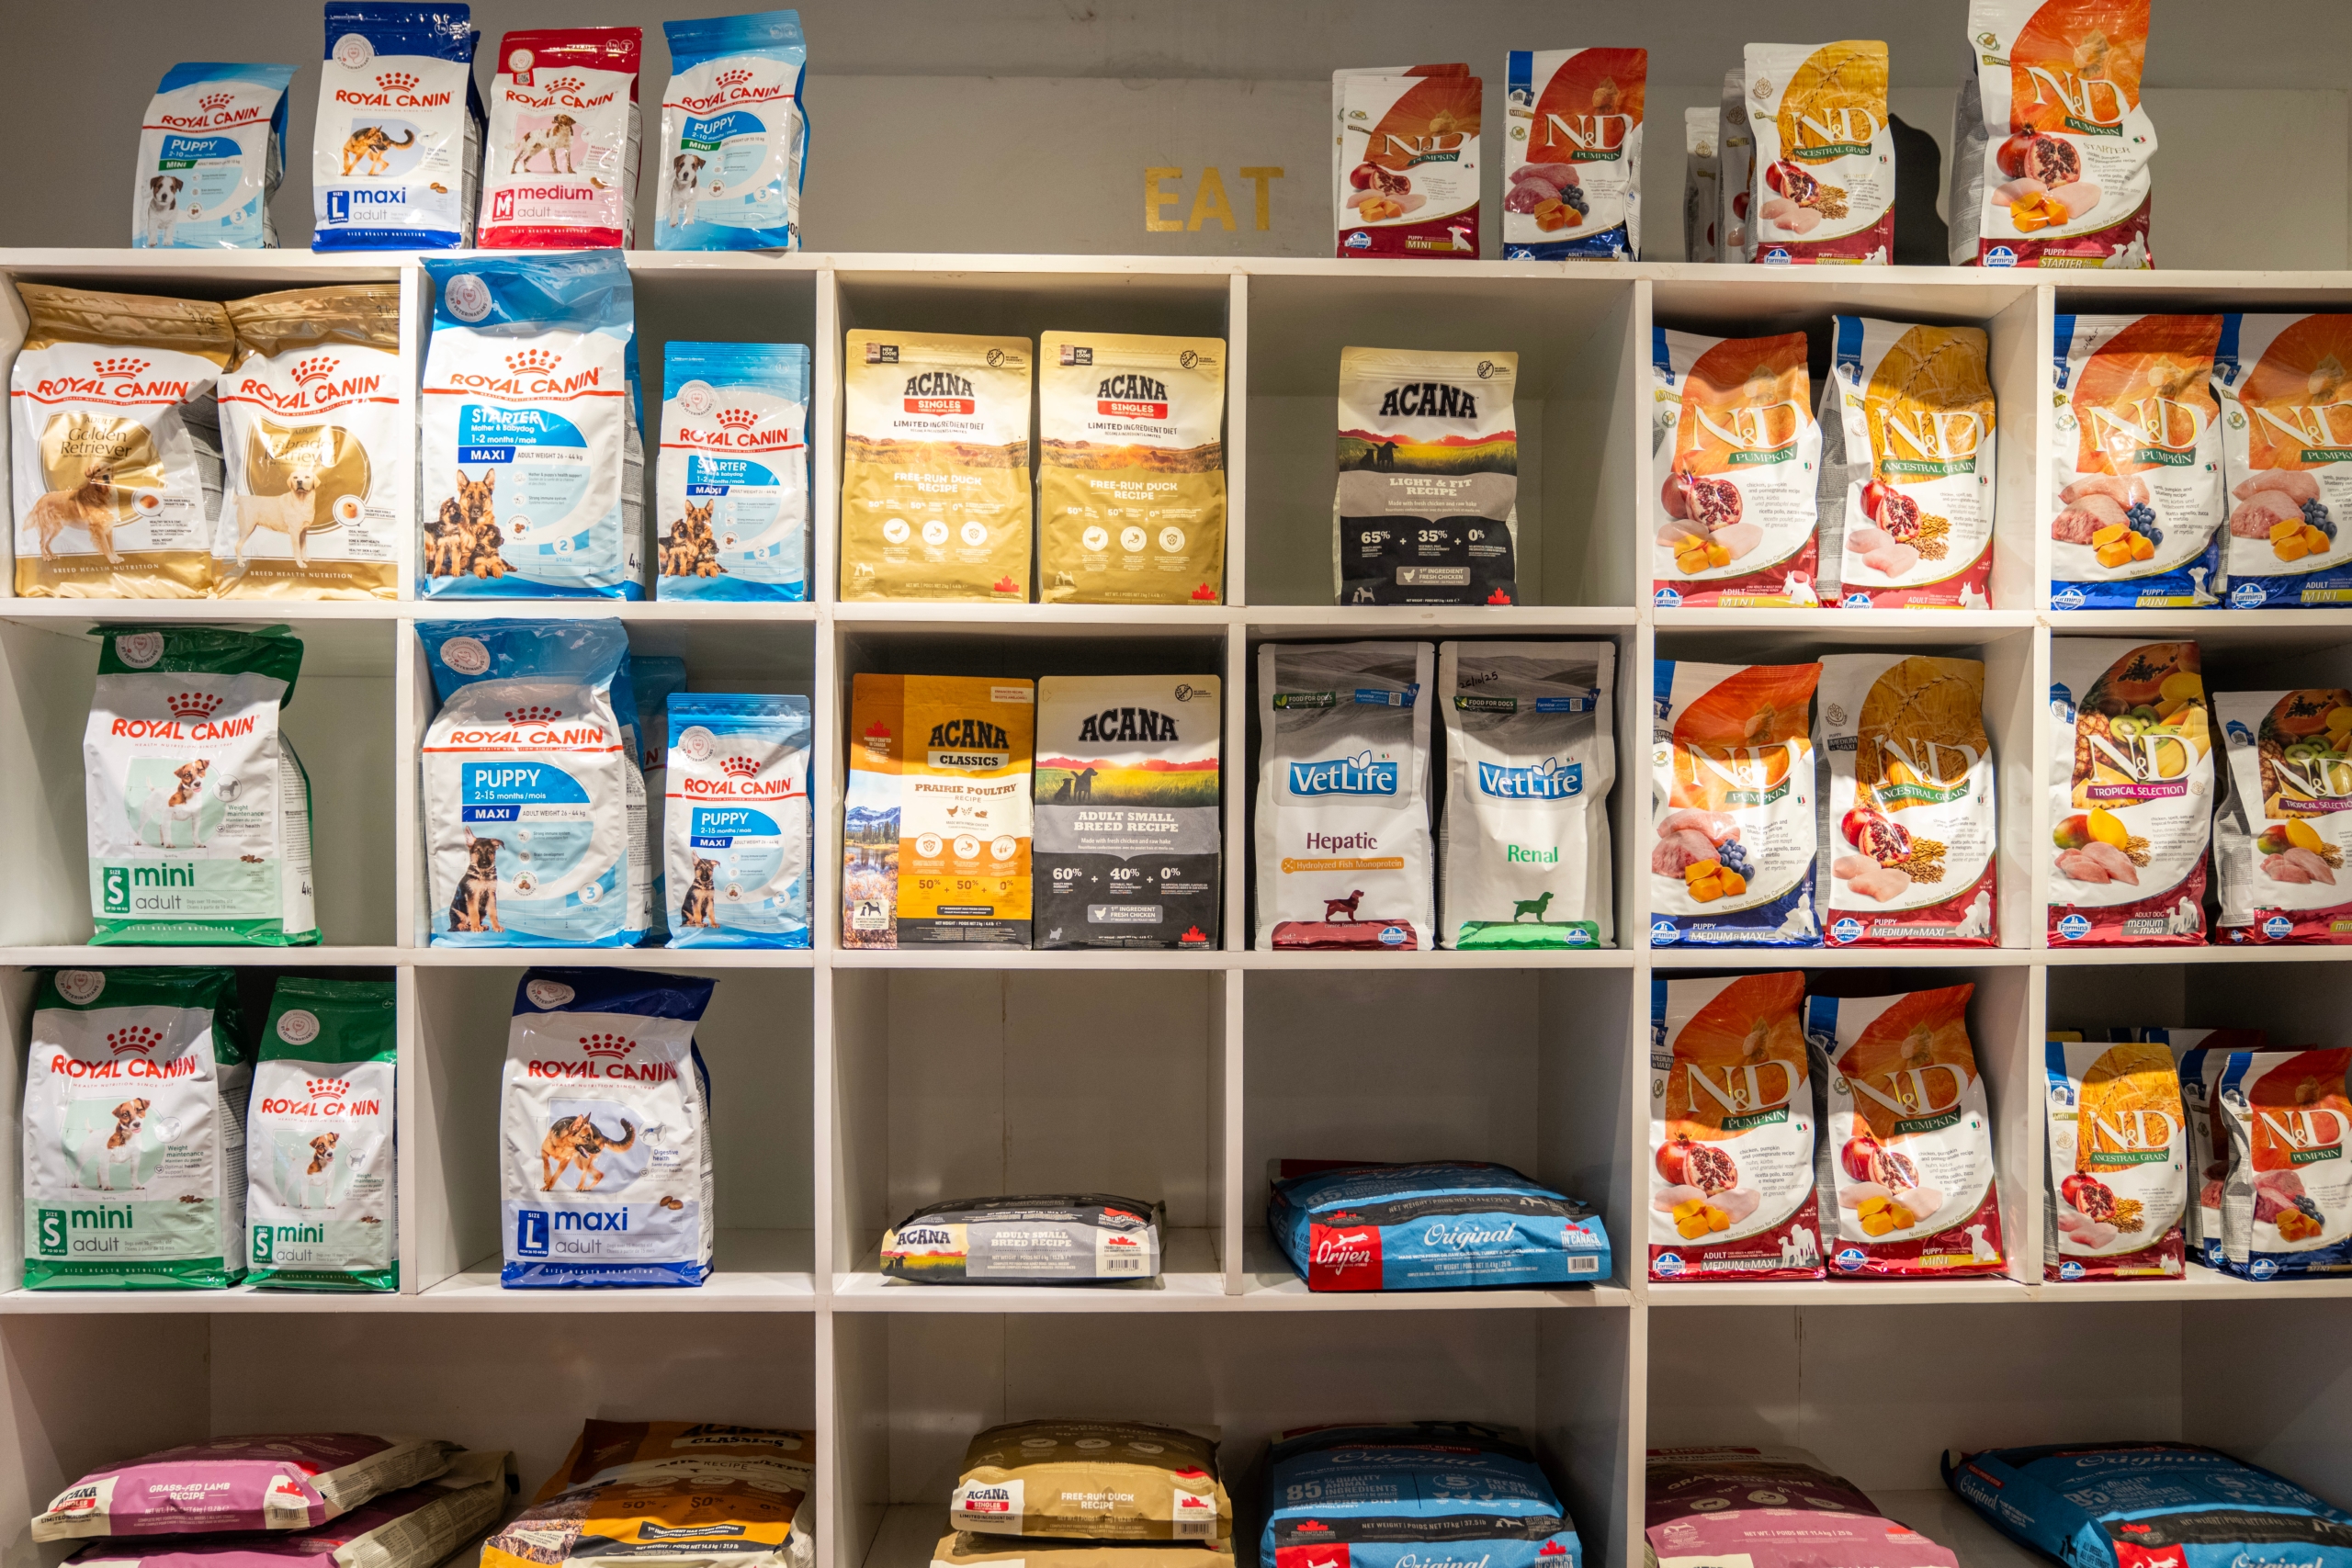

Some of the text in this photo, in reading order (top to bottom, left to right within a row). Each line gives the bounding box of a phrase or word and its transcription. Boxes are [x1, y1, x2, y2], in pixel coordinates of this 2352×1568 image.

[336, 90, 451, 107] ROYAL CANIN
[506, 90, 614, 108] ROYAL CANIN
[682, 85, 780, 110] ROYAL CANIN
[2028, 66, 2132, 126] N&D
[695, 116, 736, 134] PUPPY
[1545, 113, 1634, 151] N&D
[1792, 107, 1882, 147] N&D
[2068, 118, 2120, 136] PUMPKIN
[171, 139, 217, 152] PUPPY
[689, 141, 711, 151] MINI
[2083, 142, 2132, 155] STARTER
[1577, 150, 1621, 161] PUMPKIN
[354, 187, 406, 204] maxi
[517, 185, 594, 201] medium
[1145, 167, 1284, 231] EAT
[517, 208, 551, 218] adult
[1407, 241, 1431, 250] MINI
[1985, 254, 2016, 266] Farmina
[37, 377, 188, 399] ROYAL CANIN
[450, 367, 599, 395] ROYAL CANIN
[904, 372, 974, 397] ACANA
[1097, 374, 1168, 400] ACANA
[241, 375, 380, 409] ROYAL CANIN
[919, 400, 961, 409] SINGLES
[1379, 383, 1477, 418] ACANA
[472, 408, 541, 423] STARTER
[893, 420, 984, 431] LIMITED INGREDIENT DIET
[1692, 400, 1801, 452] N&D
[1876, 407, 1986, 457] N&D
[2086, 396, 2206, 452] N&D
[69, 428, 127, 442] Golden
[472, 434, 485, 443] 1-2
[61, 442, 132, 457] Retriever
[470, 450, 504, 460] MAXI
[1736, 449, 1794, 462] PUMPKIN
[1885, 461, 1974, 473] ANCESTRAL GRAIN
[918, 483, 957, 492] RECIPE
[951, 475, 981, 485] DUCK
[1389, 478, 1472, 488] LIGHT & FIT
[1407, 488, 1456, 496] RECIPE
[113, 563, 159, 571] NUTRITION
[2138, 597, 2168, 606] MINI
[111, 716, 254, 740] ROYAL CANIN
[1079, 707, 1179, 743] ACANA
[450, 727, 603, 745] ROYAL CANIN
[928, 719, 1009, 749] ACANA
[939, 754, 998, 767] CLASSICS
[1684, 737, 1798, 789] N&D
[2086, 734, 2199, 783] N&D
[476, 769, 540, 787] PUPPY
[684, 776, 791, 795] ROYAL CANIN
[1293, 767, 1393, 793] VetLife
[475, 791, 494, 799] 2-15
[915, 783, 1016, 795] PRAIRIE POULTRY
[1732, 785, 1787, 803] PUMPKIN
[2094, 785, 2184, 796] TROPICAL SELECTION
[475, 809, 509, 818] MAXI
[701, 813, 749, 826] PUPPY
[1079, 812, 1174, 822] ADULT SMALL
[1074, 821, 1179, 833] BREED RECIPE
[1306, 832, 1378, 853] Hepatic
[1508, 844, 1558, 863] Renal
[1296, 859, 1402, 871] Hydrolyzed Fish Monoprotein
[134, 863, 195, 886] mini
[107, 875, 124, 905] S
[136, 895, 182, 910] adult
[2060, 923, 2089, 933] Farmina
[51, 1055, 196, 1079] ROYAL CANIN
[528, 1060, 677, 1082] ROYAL CANIN
[1685, 1059, 1800, 1115] N&D
[1728, 1110, 1786, 1129] PUMPKIN
[2087, 1110, 2177, 1149] N&D
[2258, 1108, 2351, 1149] N&D
[654, 1148, 679, 1157] Digestive
[2094, 1153, 2167, 1162] ANCESTRAL GRAIN
[2293, 1149, 2339, 1160] PUMPKIN
[73, 1204, 133, 1228] mini
[554, 1207, 628, 1231] maxi
[277, 1224, 323, 1243] mini
[526, 1220, 542, 1248] L
[898, 1229, 950, 1245] ACANA
[1424, 1223, 1516, 1250] Original
[73, 1237, 119, 1252] adult
[555, 1239, 601, 1254] adult
[990, 1238, 1071, 1247] BREED RECIPE
[1317, 1240, 1371, 1276] Orijen
[704, 1461, 748, 1471] RECIPE
[149, 1483, 230, 1493] GRASS-FED LAMB
[170, 1492, 205, 1500] RECIPE
[967, 1488, 1009, 1500] ACANA
[1287, 1481, 1322, 1500] 85
[1325, 1484, 1397, 1495] INGREDIENTS
[1959, 1476, 1999, 1512] Original
[1061, 1492, 1134, 1502] FREE-RUN DUCK
[1081, 1501, 1114, 1510] RECIPE
